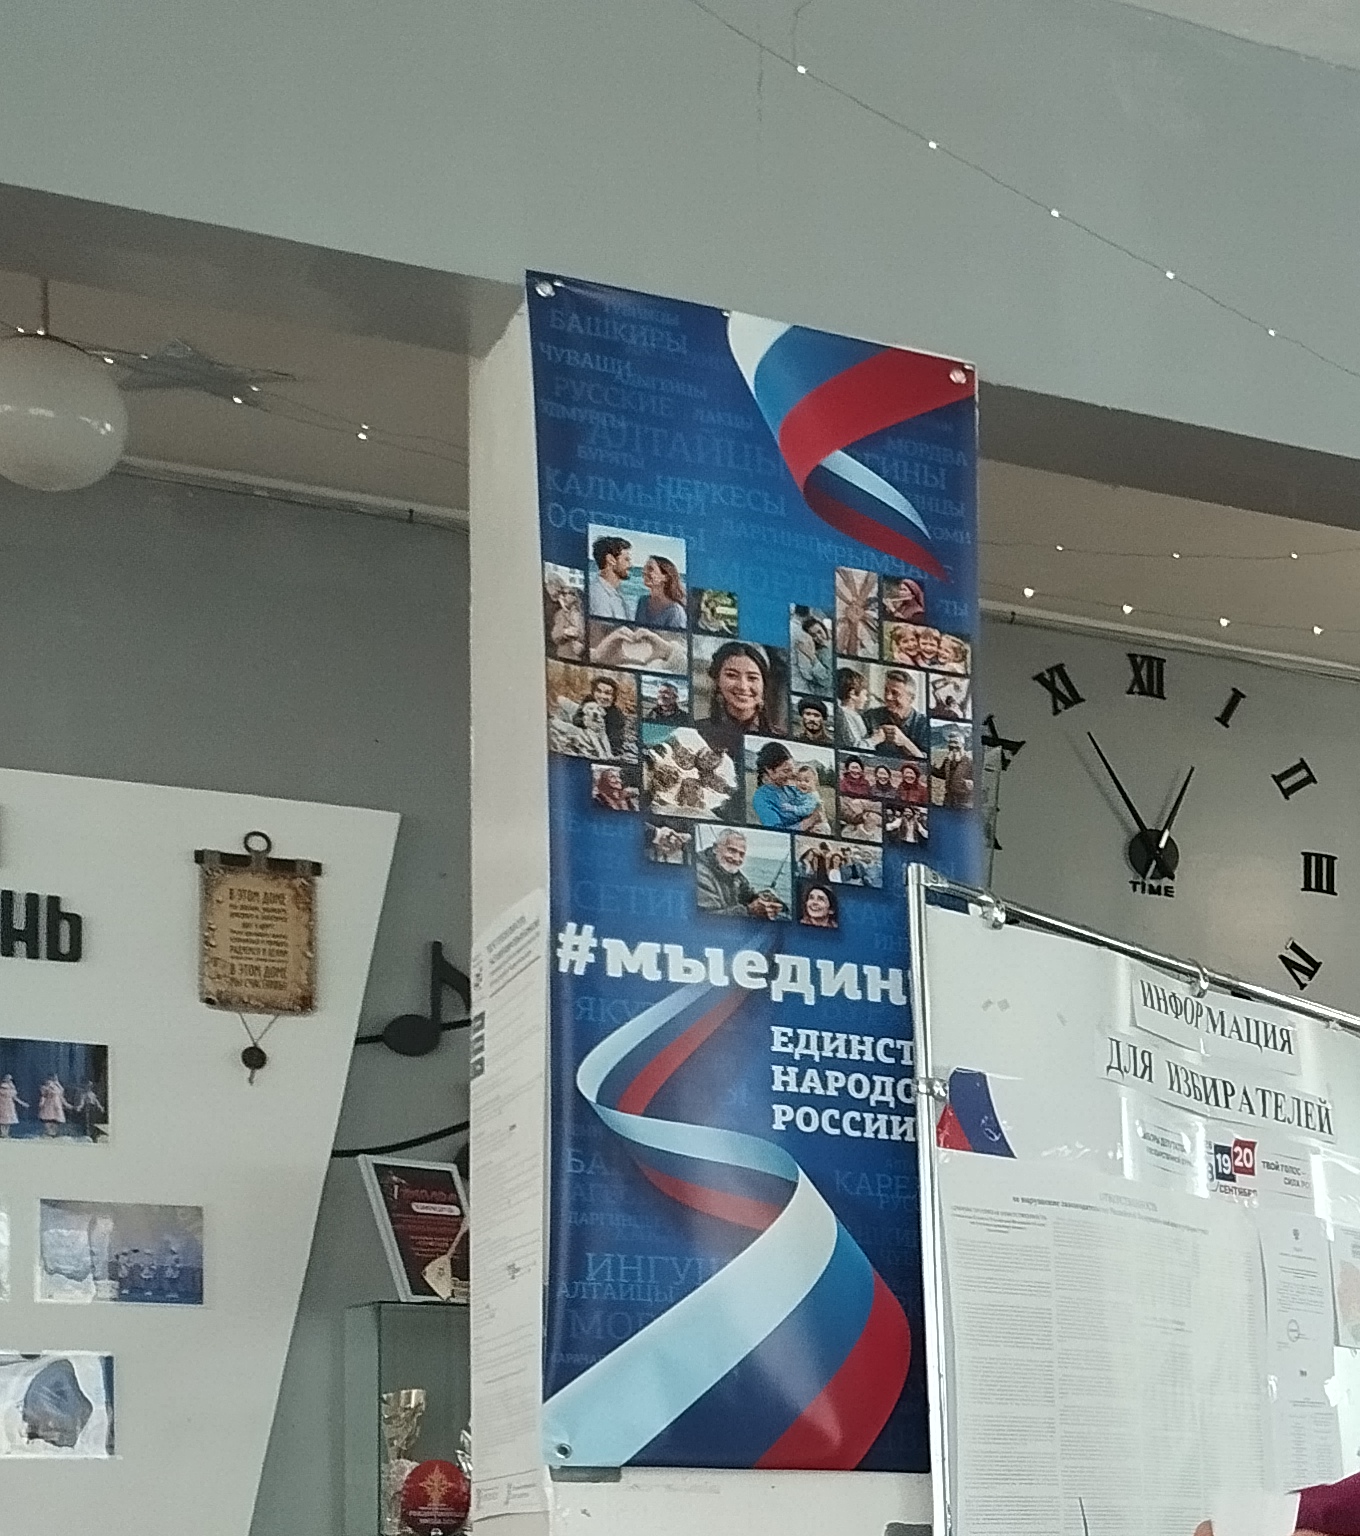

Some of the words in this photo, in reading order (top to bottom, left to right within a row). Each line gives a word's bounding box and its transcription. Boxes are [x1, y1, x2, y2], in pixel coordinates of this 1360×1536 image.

[1032, 662, 1087, 717] XI
[1126, 653, 1167, 701] XII
[1271, 757, 1318, 801] II
[1128, 879, 1176, 899] TIME
[1300, 851, 1339, 897] III
[0, 889, 83, 963] НЬ
[555, 921, 911, 1006] #мыедин
[1139, 979, 1295, 1055] ИНФОРМАЦИЯ
[770, 1025, 915, 1065] ЕДИНСТ
[770, 1064, 915, 1107] НАРОДО
[1106, 1036, 1154, 1084] ДЛЯ
[1165, 1059, 1334, 1136] ИЗБИРАТЕЛЕЙ
[771, 1103, 917, 1143] РОССИИ
[1216, 1153, 1232, 1175] 19
[1233, 1146, 1254, 1169] 20
